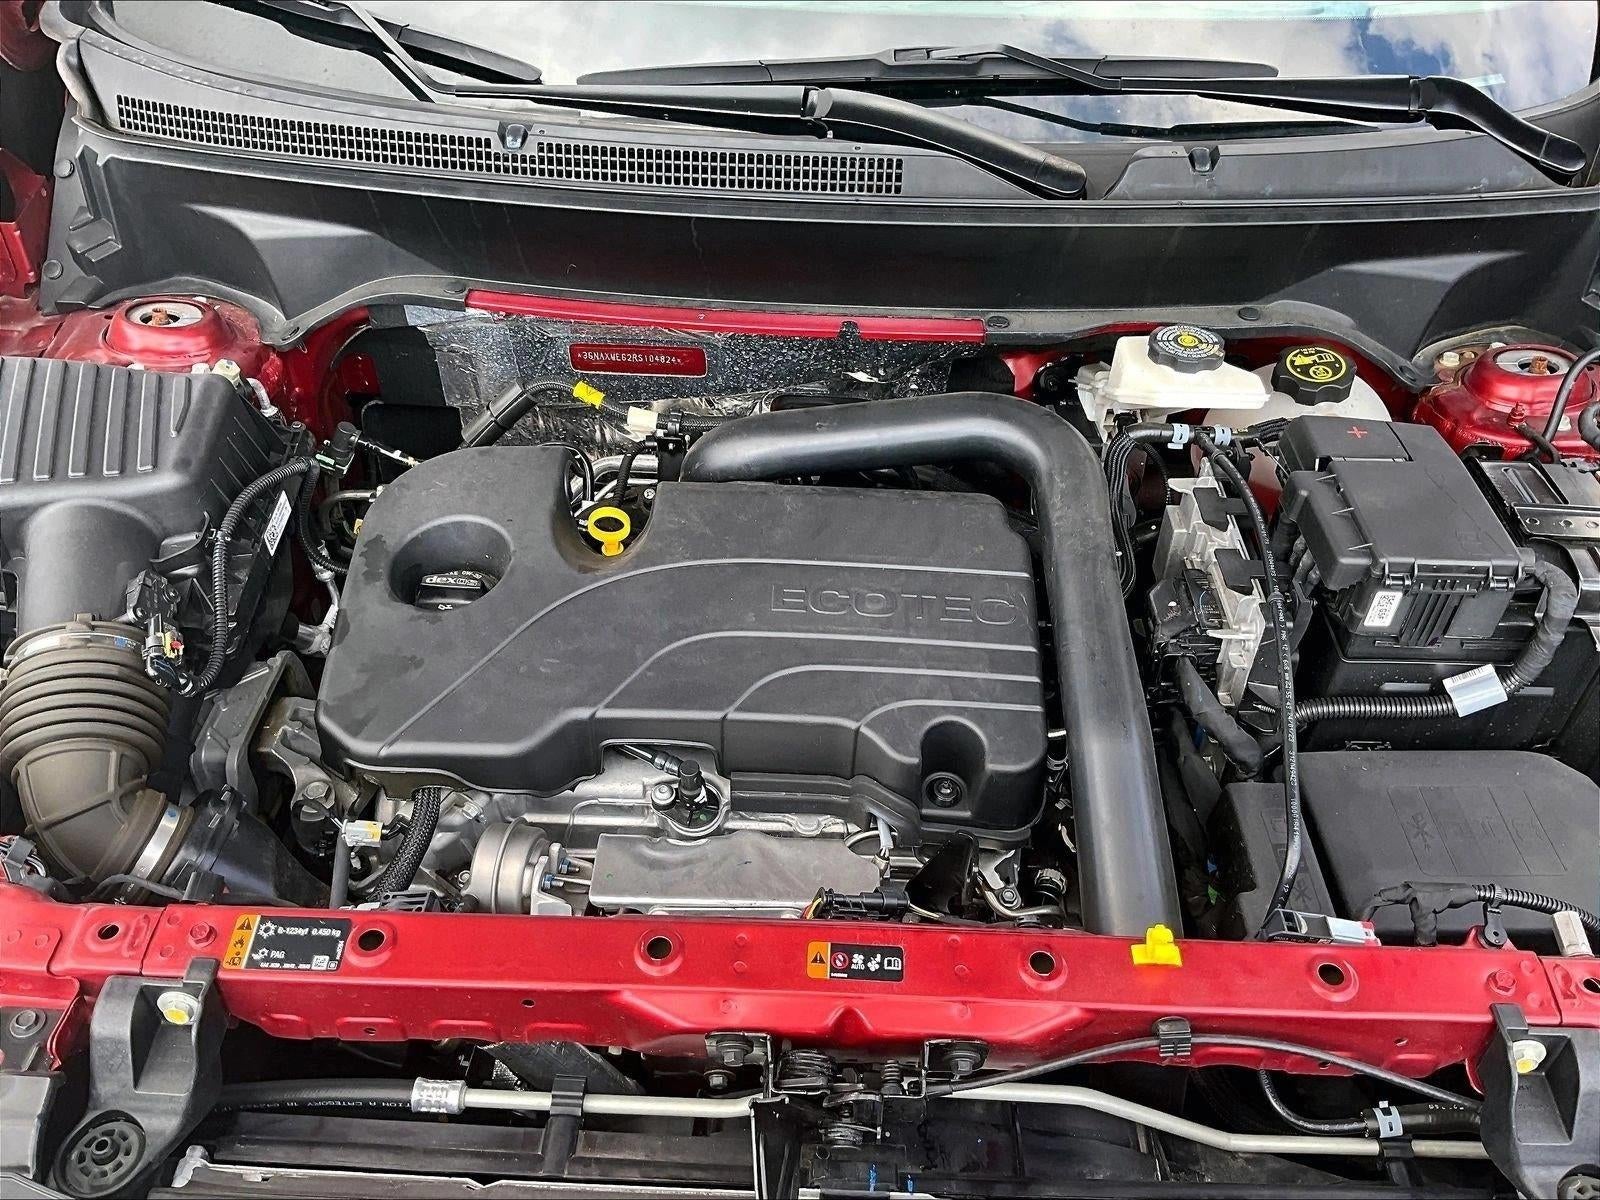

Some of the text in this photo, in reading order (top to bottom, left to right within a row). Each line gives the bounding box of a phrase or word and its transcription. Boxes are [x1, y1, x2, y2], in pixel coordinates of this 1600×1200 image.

[771, 585, 1017, 626] ECOTEC
[270, 950, 286, 959] PAG
[306, 1100, 363, 1108] CATEGORY
